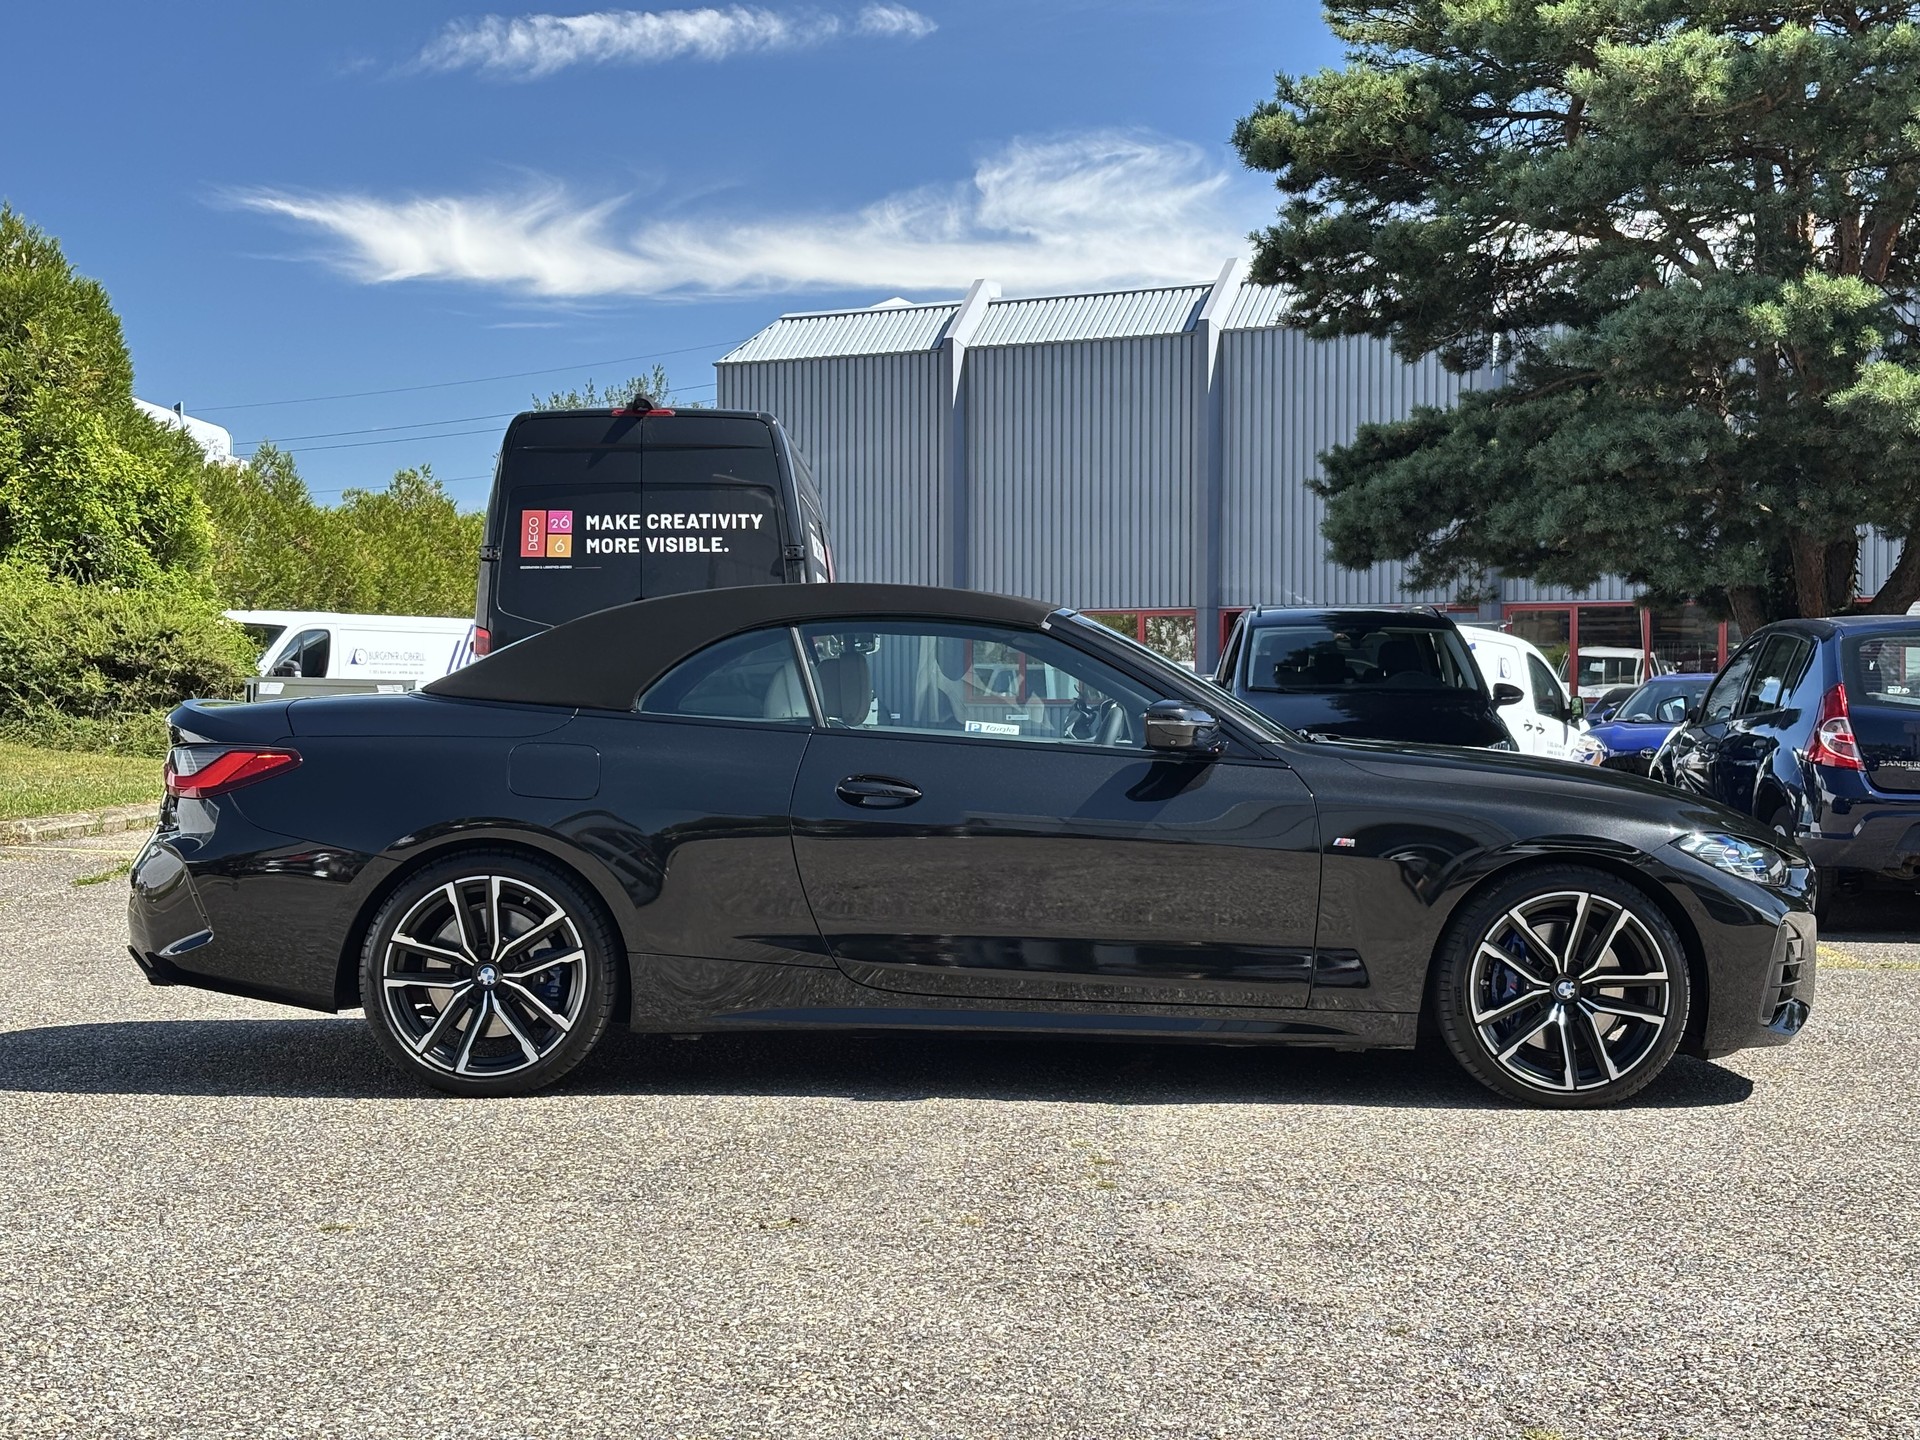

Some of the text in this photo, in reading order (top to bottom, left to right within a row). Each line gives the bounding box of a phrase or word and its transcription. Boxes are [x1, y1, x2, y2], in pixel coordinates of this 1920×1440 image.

[550, 515, 570, 529] 26
[586, 513, 763, 530] MAKE CREATIVITY
[528, 517, 539, 551] DECO
[554, 539, 565, 553] 6
[586, 537, 729, 554] MORE VISIBLE.
